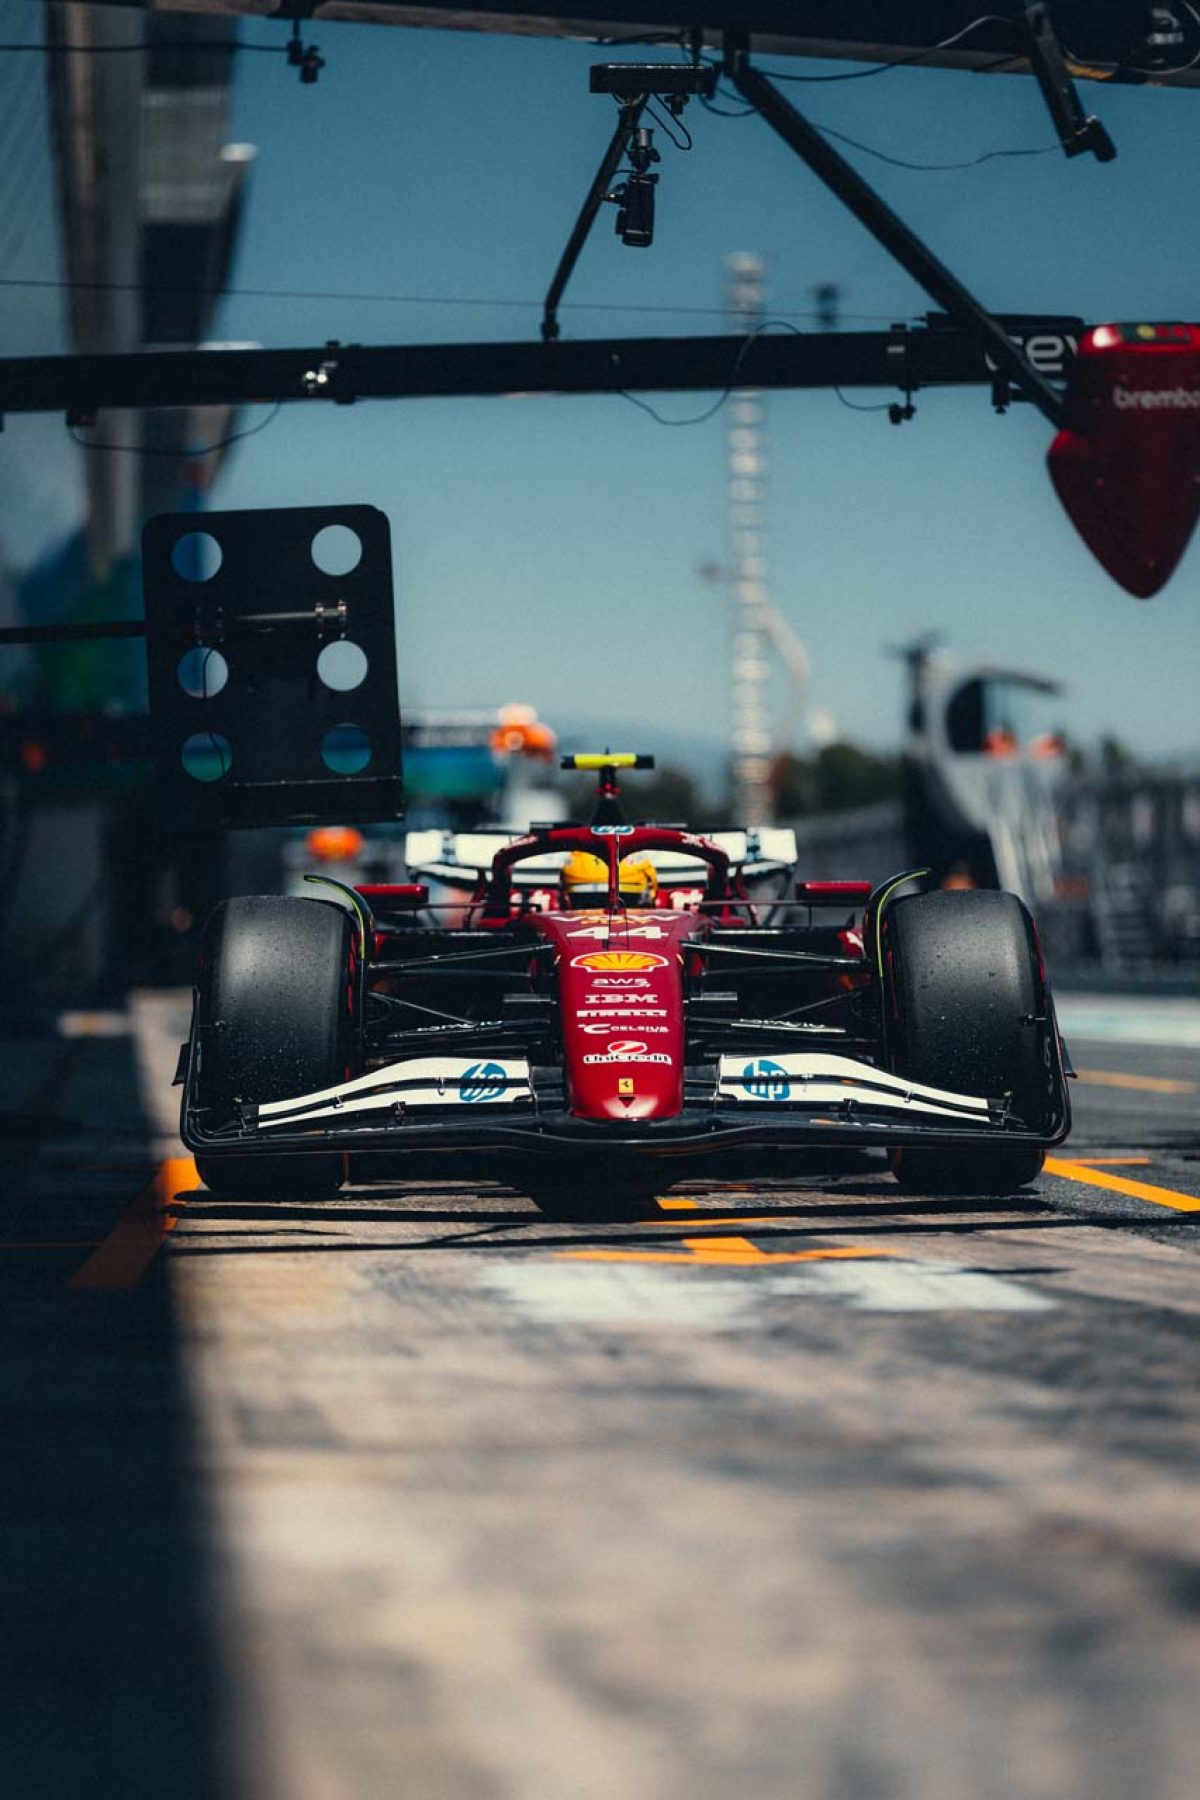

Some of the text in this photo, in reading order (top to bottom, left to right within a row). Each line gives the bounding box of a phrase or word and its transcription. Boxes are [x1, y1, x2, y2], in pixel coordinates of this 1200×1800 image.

[567, 927, 669, 939] 44
[592, 978, 650, 987] aws
[585, 994, 658, 1004] IBM
[460, 1061, 507, 1101] hp
[743, 1060, 790, 1100] hp
